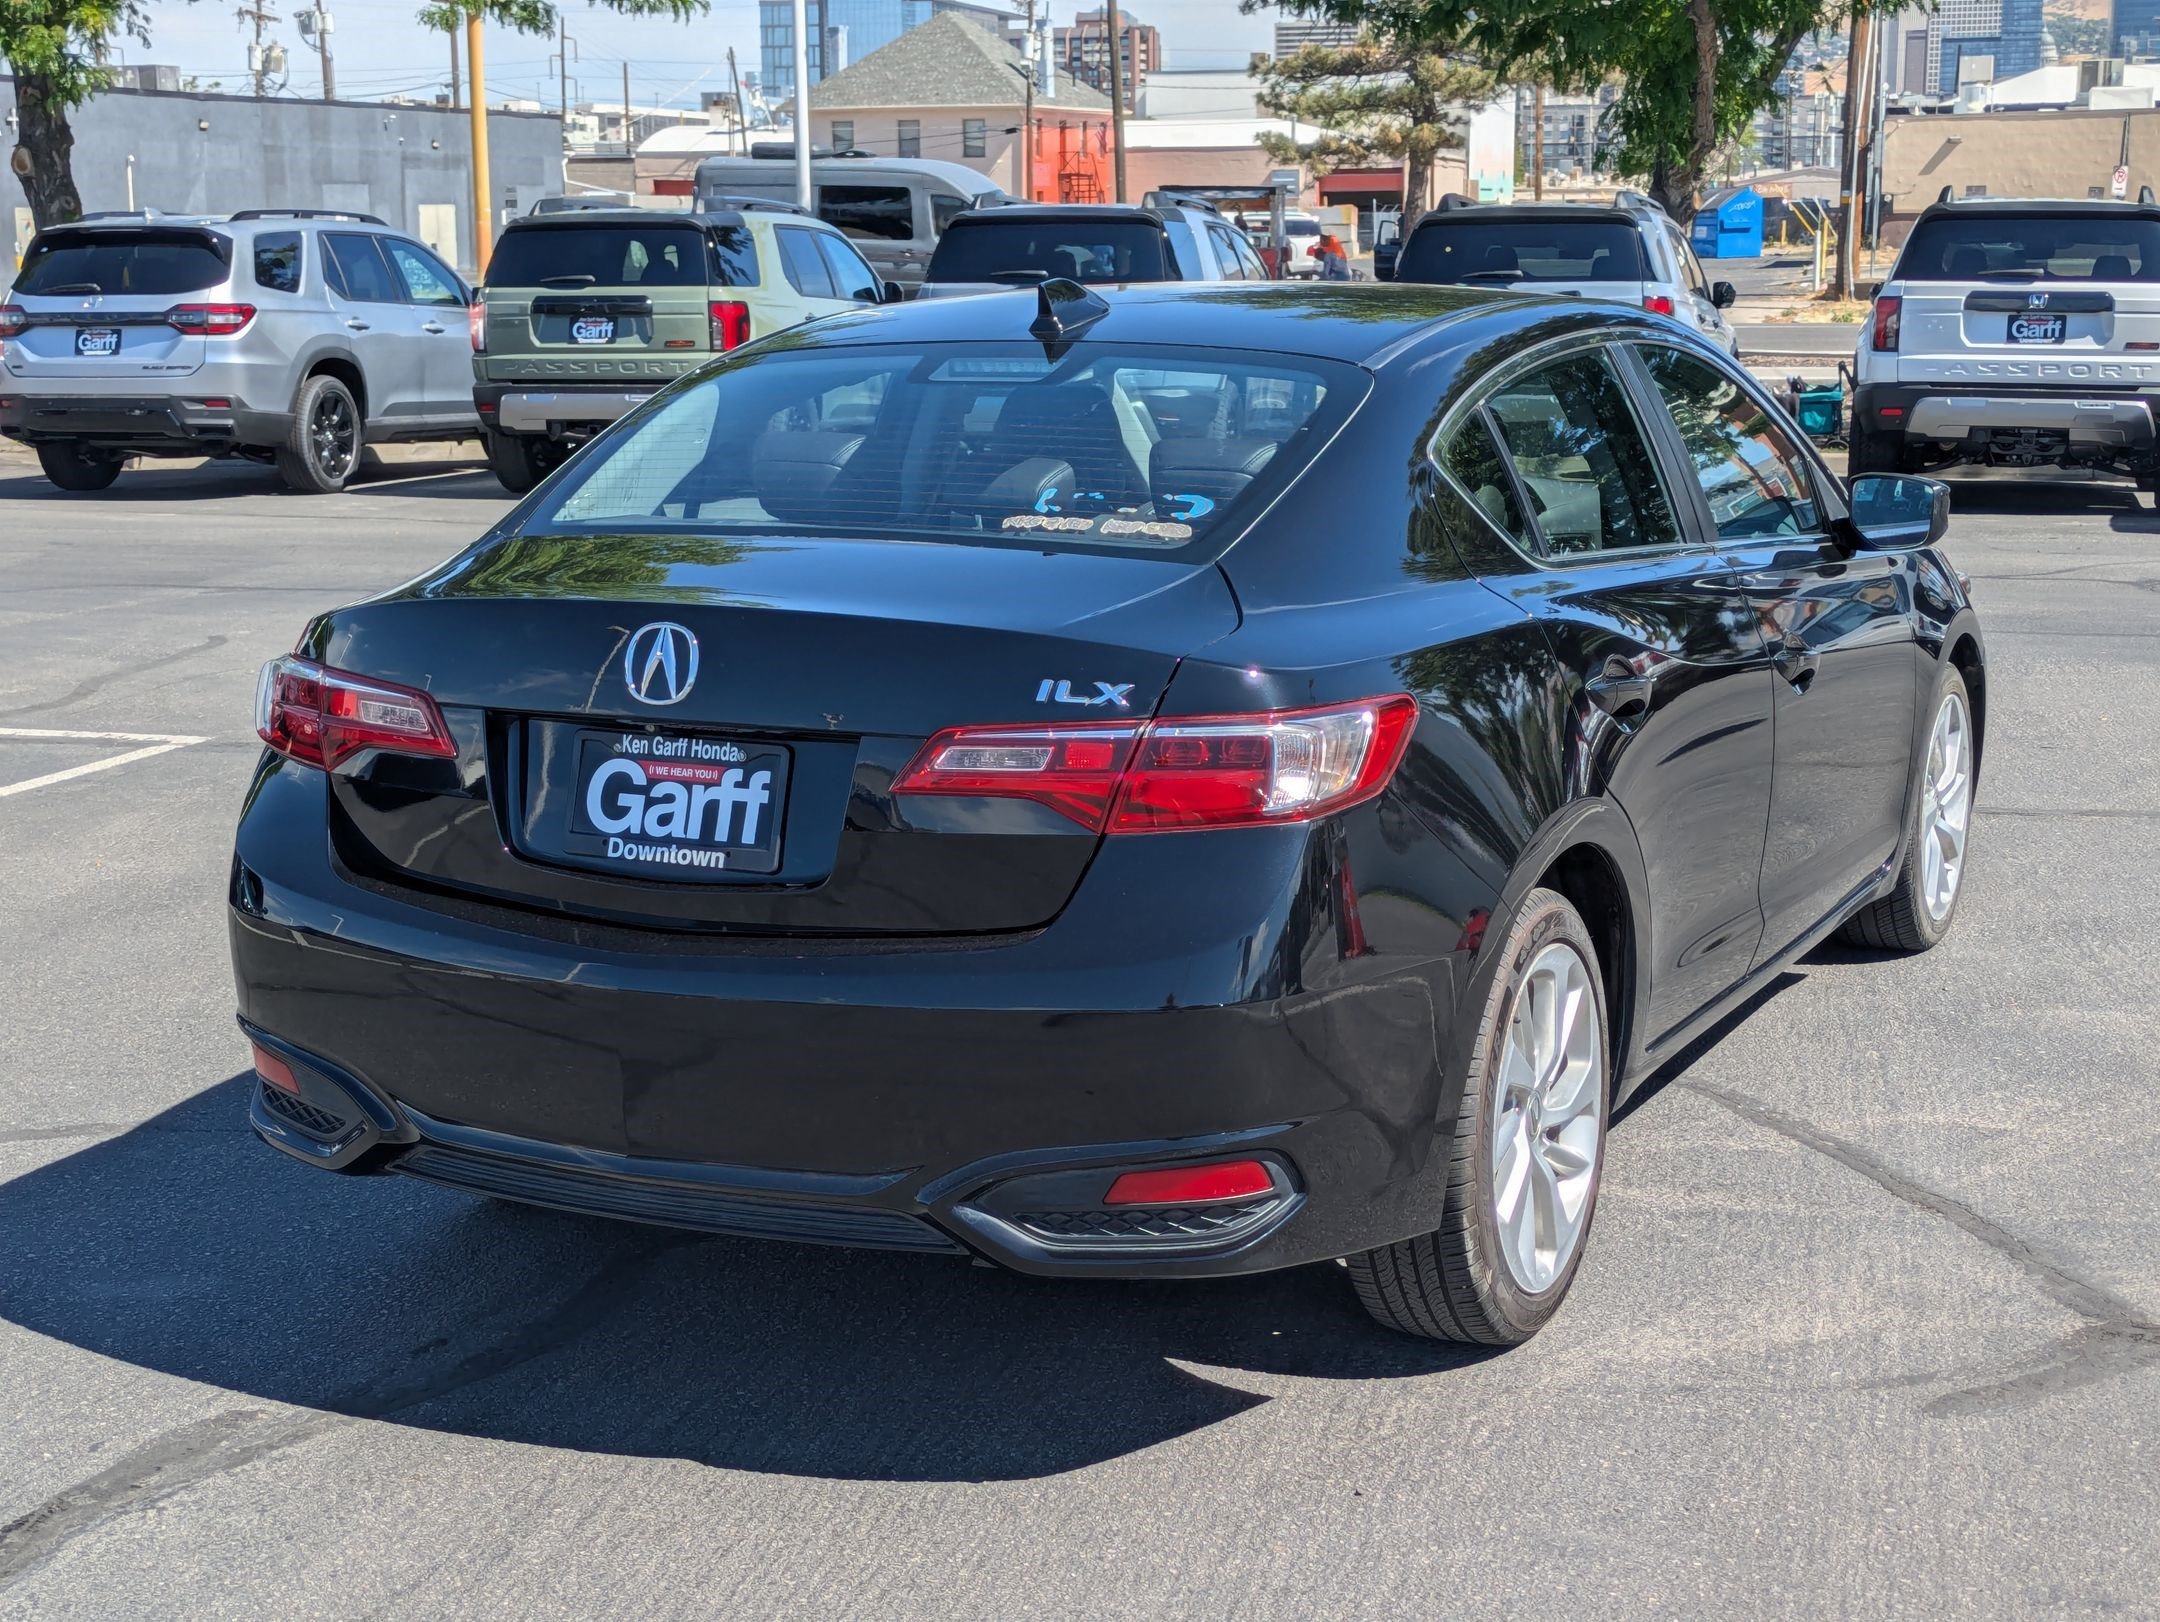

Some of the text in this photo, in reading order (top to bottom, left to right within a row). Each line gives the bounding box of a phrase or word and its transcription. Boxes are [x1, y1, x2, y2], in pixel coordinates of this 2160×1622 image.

[572, 321, 614, 338] Garff
[2012, 320, 2062, 338] Garff
[78, 334, 118, 350] Garff
[1925, 362, 2154, 379] ASSPORT
[1035, 678, 1135, 706] ILX
[622, 734, 738, 762] Ken Garff Honda
[655, 766, 714, 779] WE HEAR YOU
[586, 758, 771, 845] Garff
[607, 837, 725, 868] Downtown
